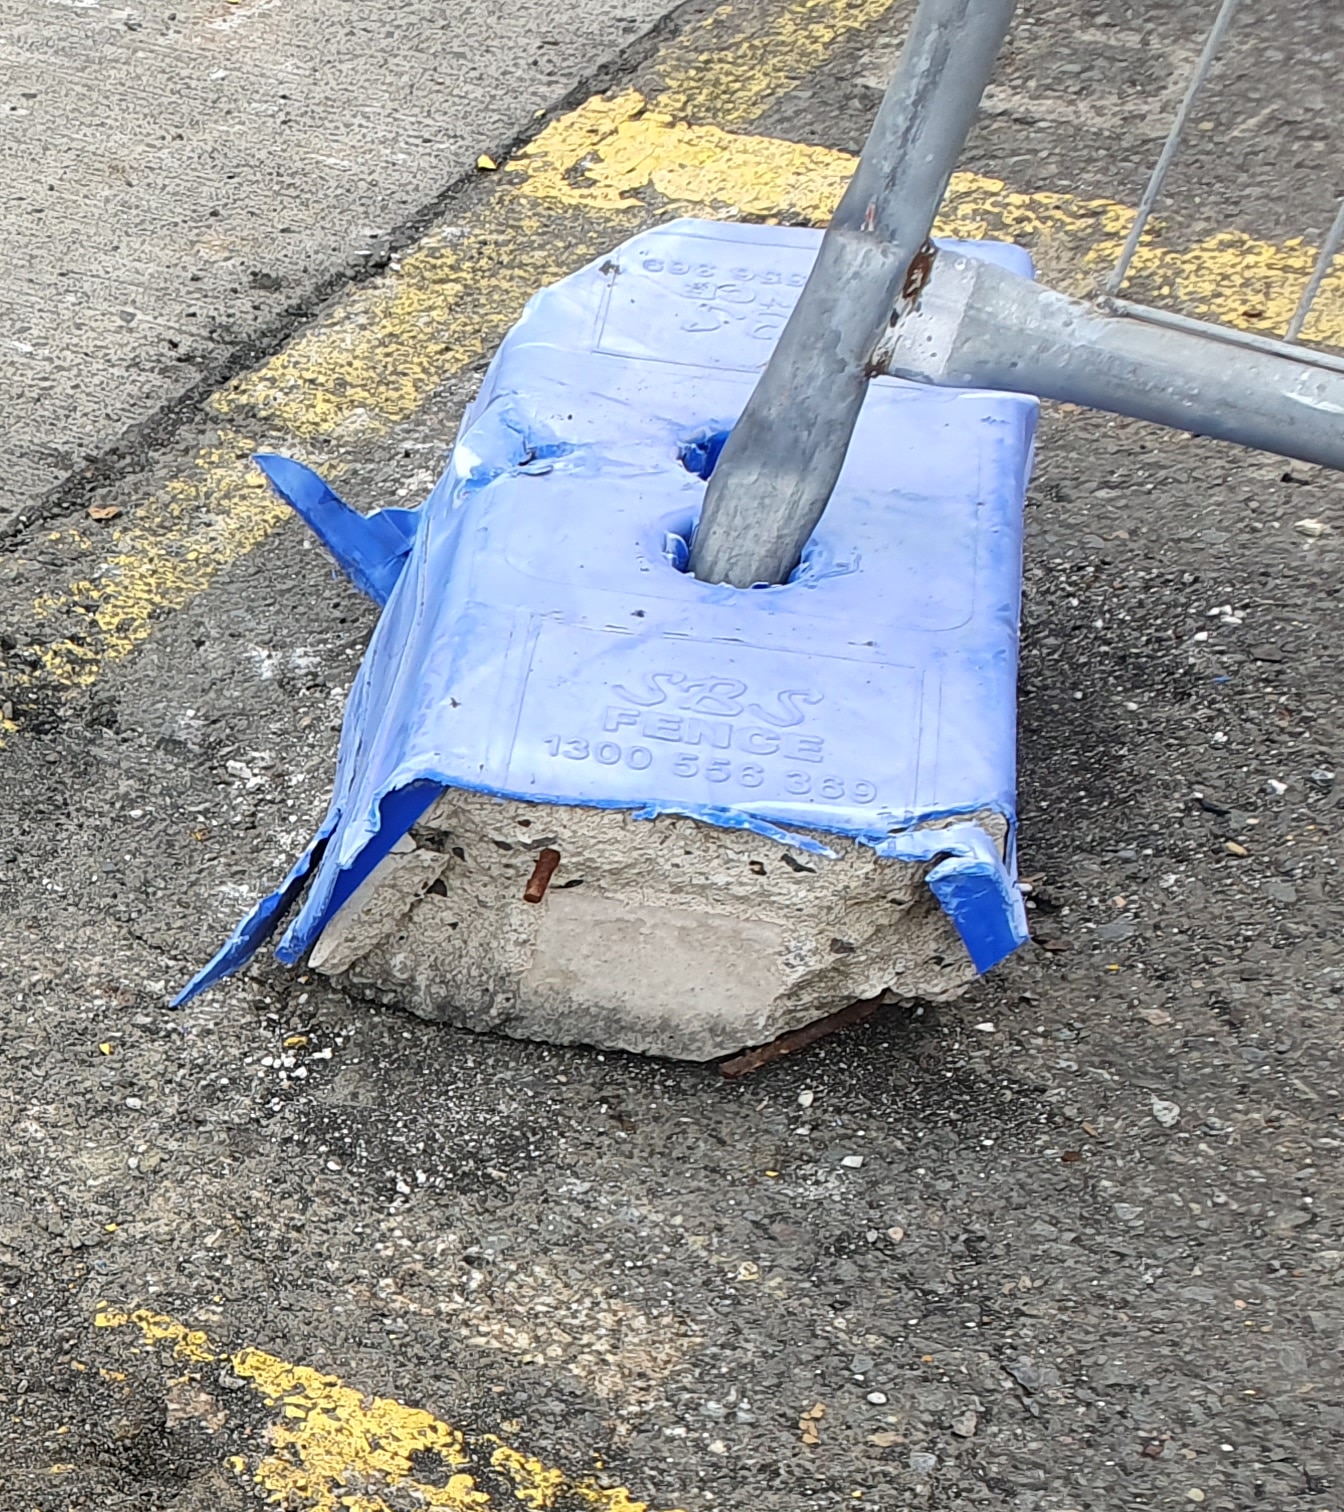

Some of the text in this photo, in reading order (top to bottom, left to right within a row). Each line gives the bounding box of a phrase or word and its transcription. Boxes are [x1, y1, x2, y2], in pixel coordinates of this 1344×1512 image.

[610, 671, 825, 728] SBS
[601, 705, 826, 764] FENCE
[542, 734, 879, 805] 1300 556 369
